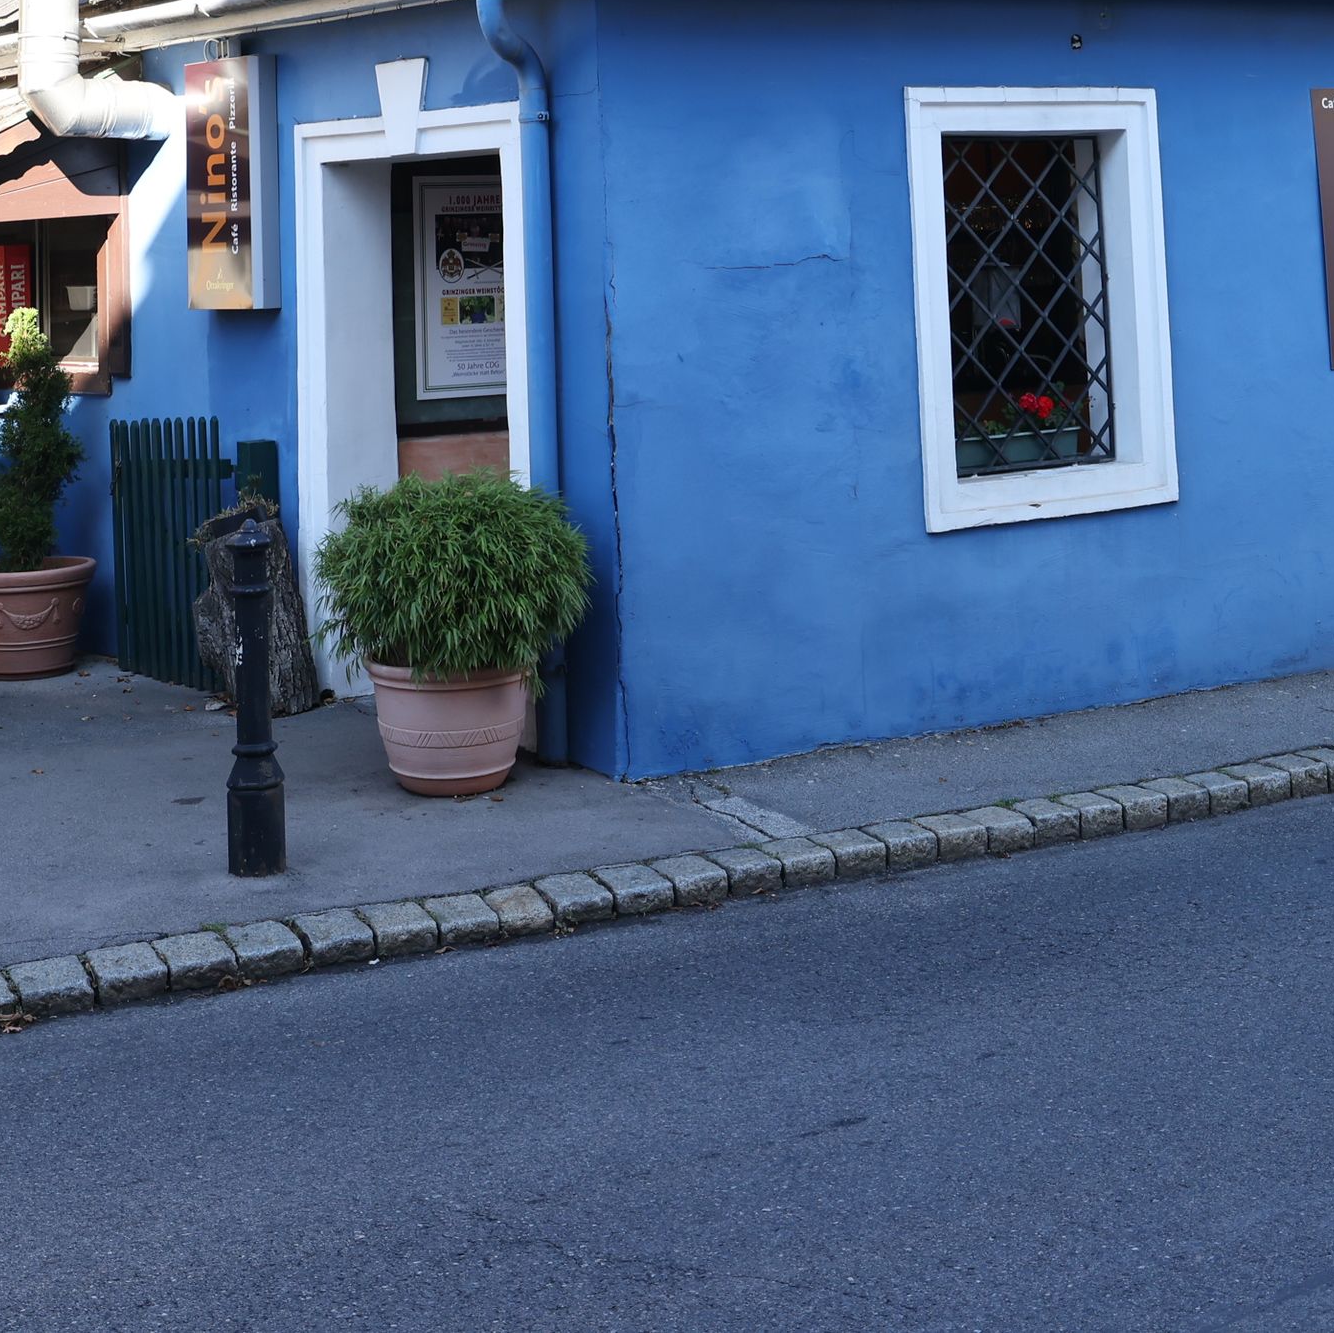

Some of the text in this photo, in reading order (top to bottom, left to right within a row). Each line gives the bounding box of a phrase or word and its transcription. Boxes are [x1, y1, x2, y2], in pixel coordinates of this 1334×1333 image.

[230, 141, 238, 212] Ristorante
[231, 223, 239, 255] Café
[476, 286, 504, 294] WEINSTÖC
